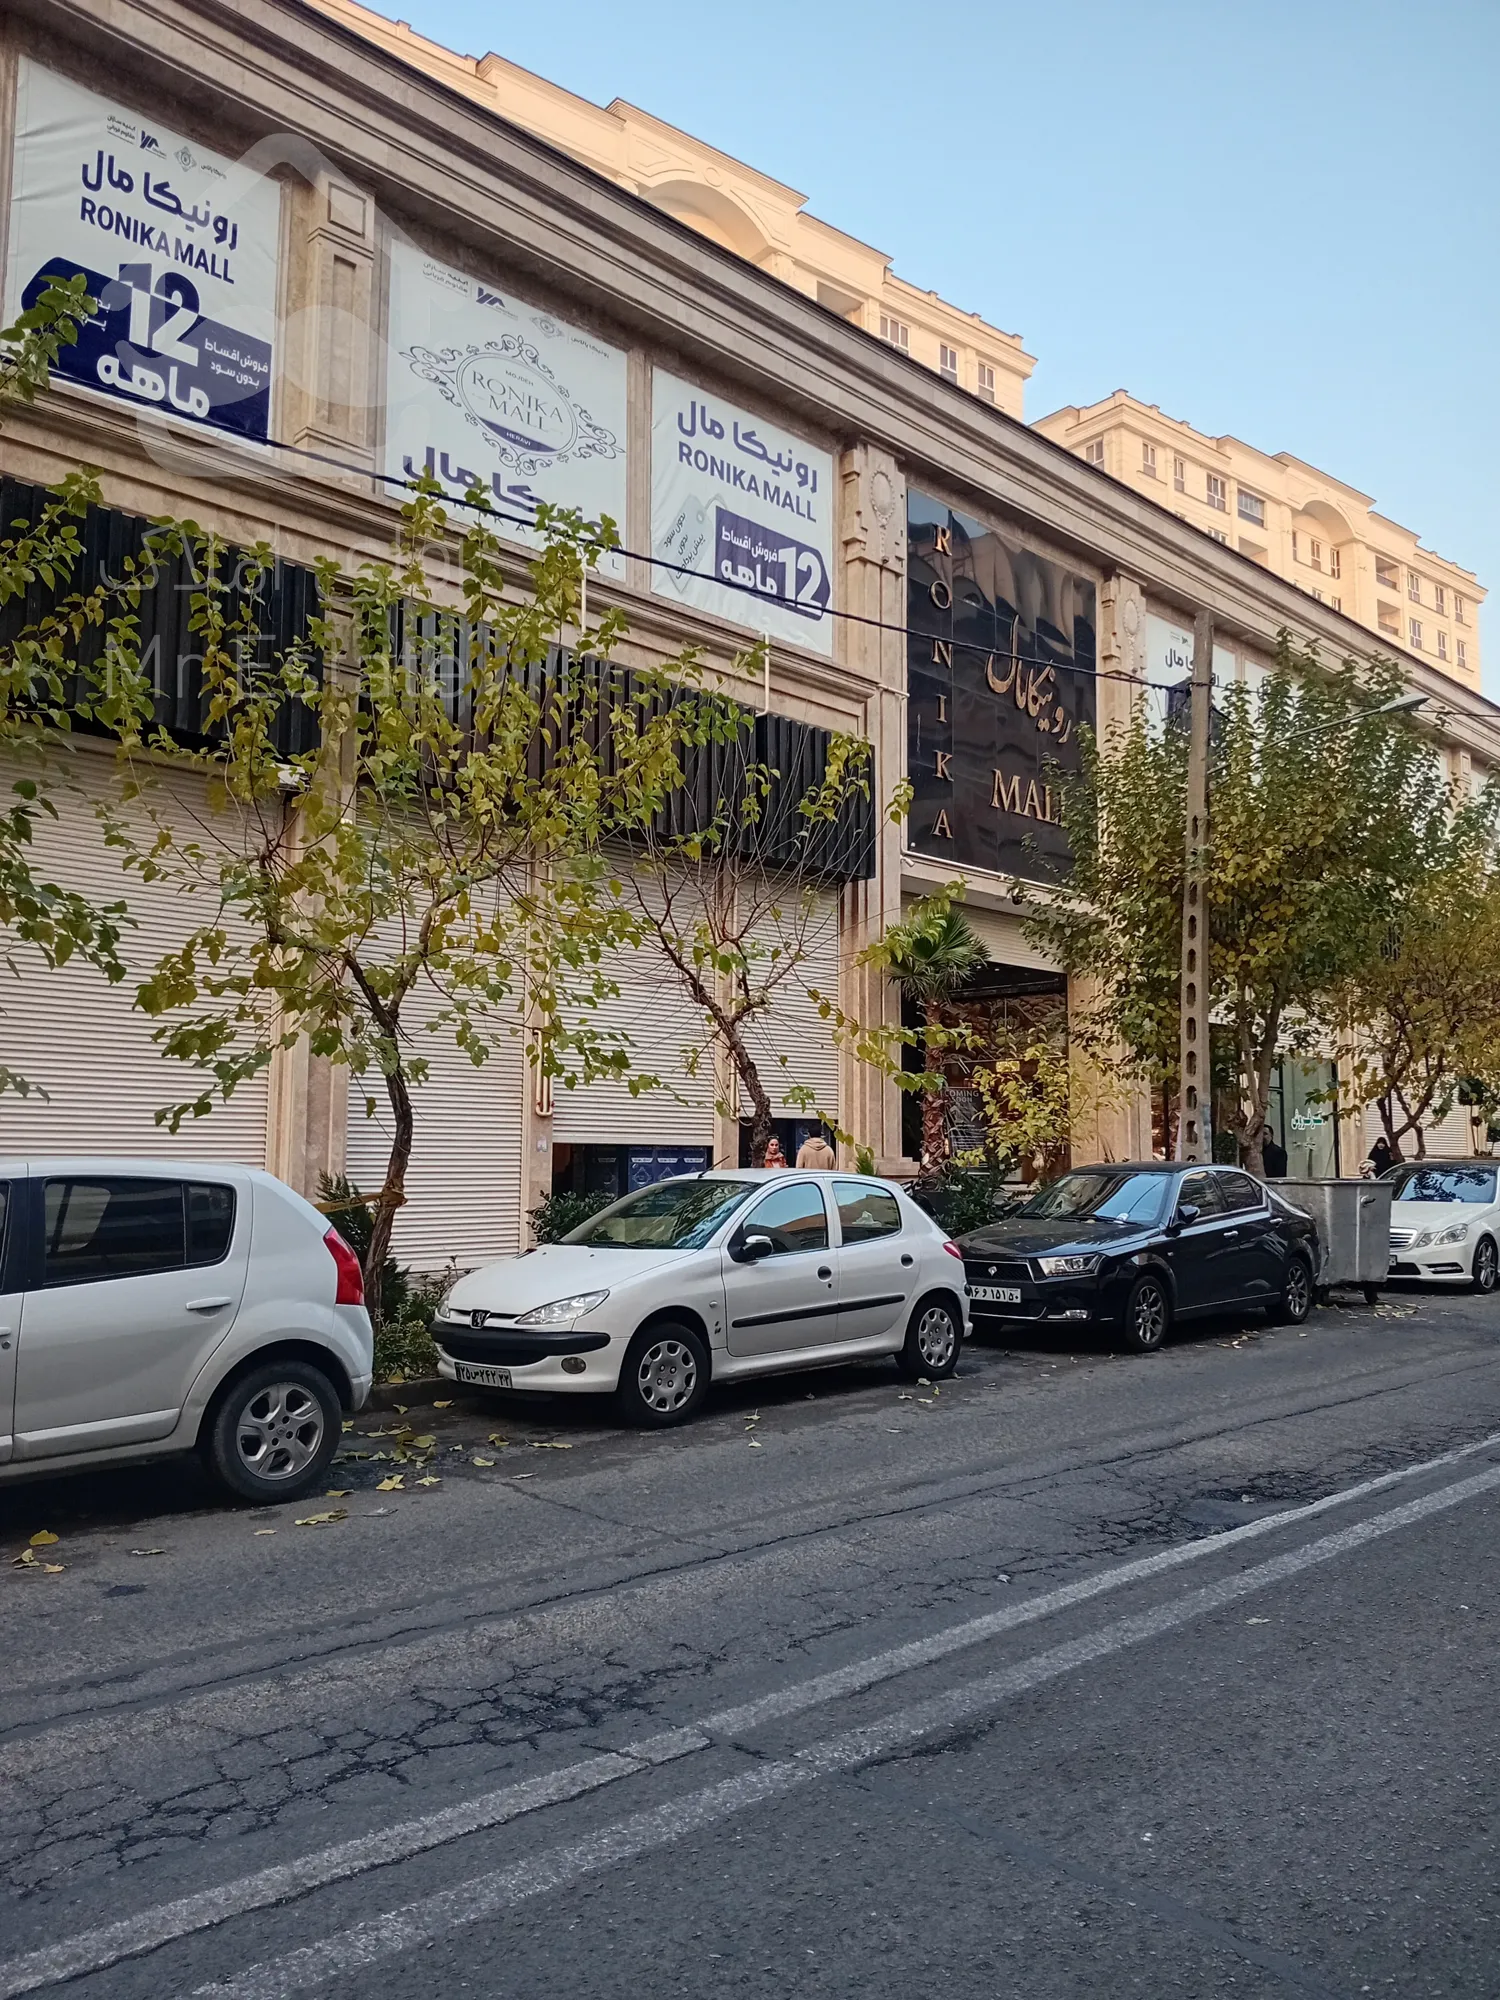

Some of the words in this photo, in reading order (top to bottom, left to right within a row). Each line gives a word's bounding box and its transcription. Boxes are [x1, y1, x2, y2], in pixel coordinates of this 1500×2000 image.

[81, 149, 135, 194] مال
[79, 196, 172, 258] RONIKA
[174, 235, 236, 285] MALL
[142, 172, 239, 251] رونیکا
[118, 262, 200, 367] 12
[97, 353, 211, 419] ماهه
[239, 351, 269, 374] فروش
[472, 370, 564, 423] RONIKA
[489, 395, 549, 433] MALL
[677, 400, 725, 440] مال
[678, 441, 761, 498] RONIKA
[763, 479, 817, 523] MALL
[732, 421, 818, 494] رونیکا
[720, 556, 778, 598] ماهه
[778, 546, 823, 617] 12
[930, 522, 954, 839] RONIKA
